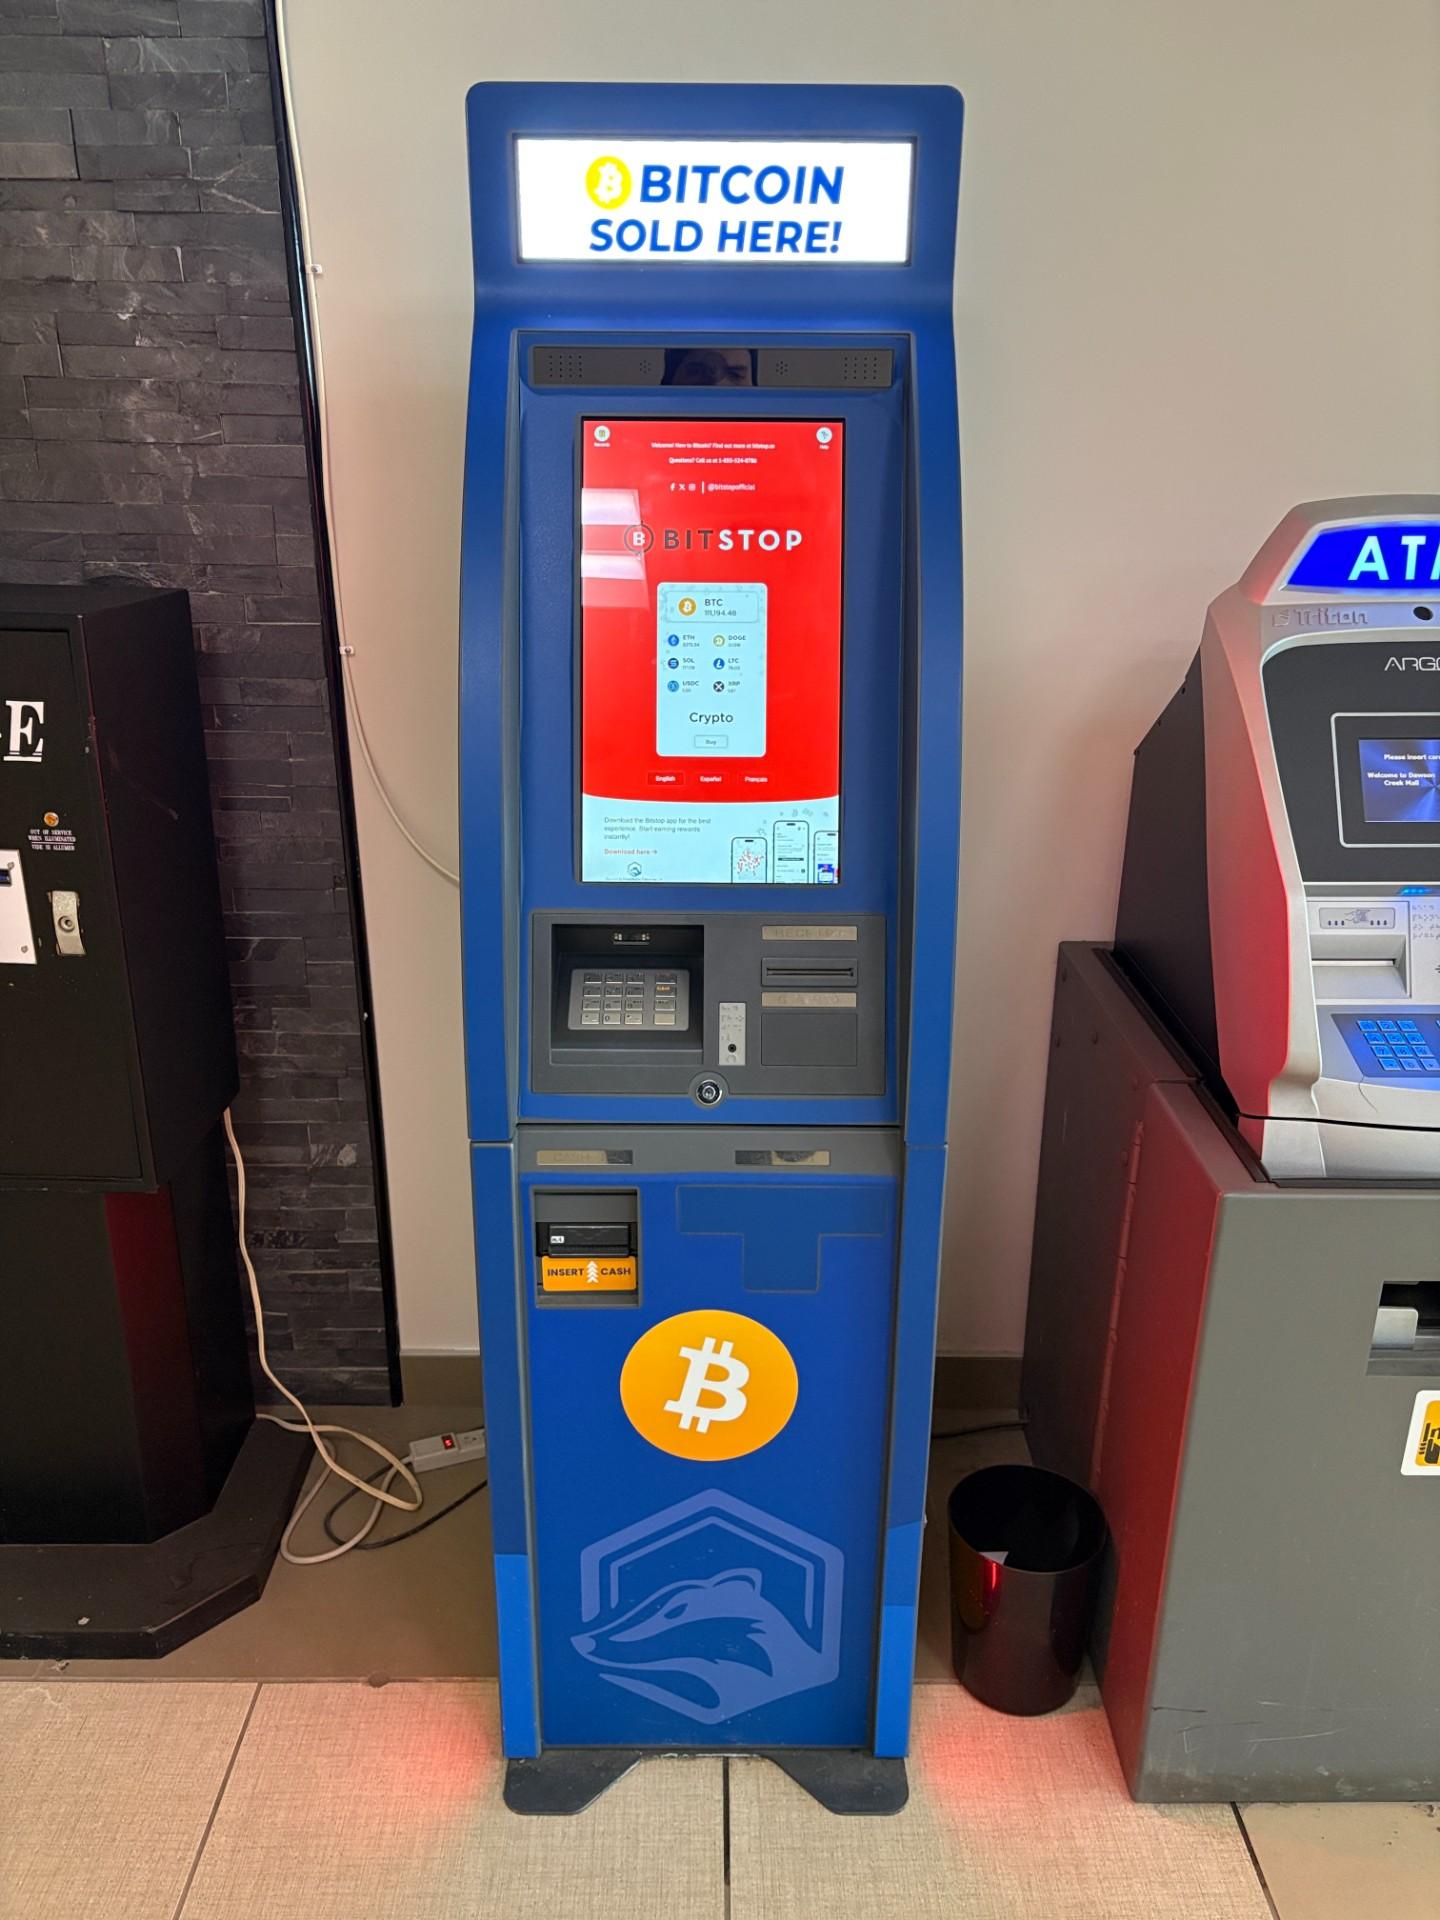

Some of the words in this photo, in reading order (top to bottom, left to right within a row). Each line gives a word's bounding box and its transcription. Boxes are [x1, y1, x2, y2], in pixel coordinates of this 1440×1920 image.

[640, 164, 844, 205] BITCOIN
[589, 218, 703, 252] SOLD
[717, 220, 842, 254] HERE!
[707, 483, 756, 492] @bitstopofficial
[664, 529, 802, 551] BITSTOP
[1293, 608, 1368, 626] Triton
[689, 712, 733, 725] Crypto
[0, 700, 44, 762] E
[548, 1268, 584, 1276] INSERT
